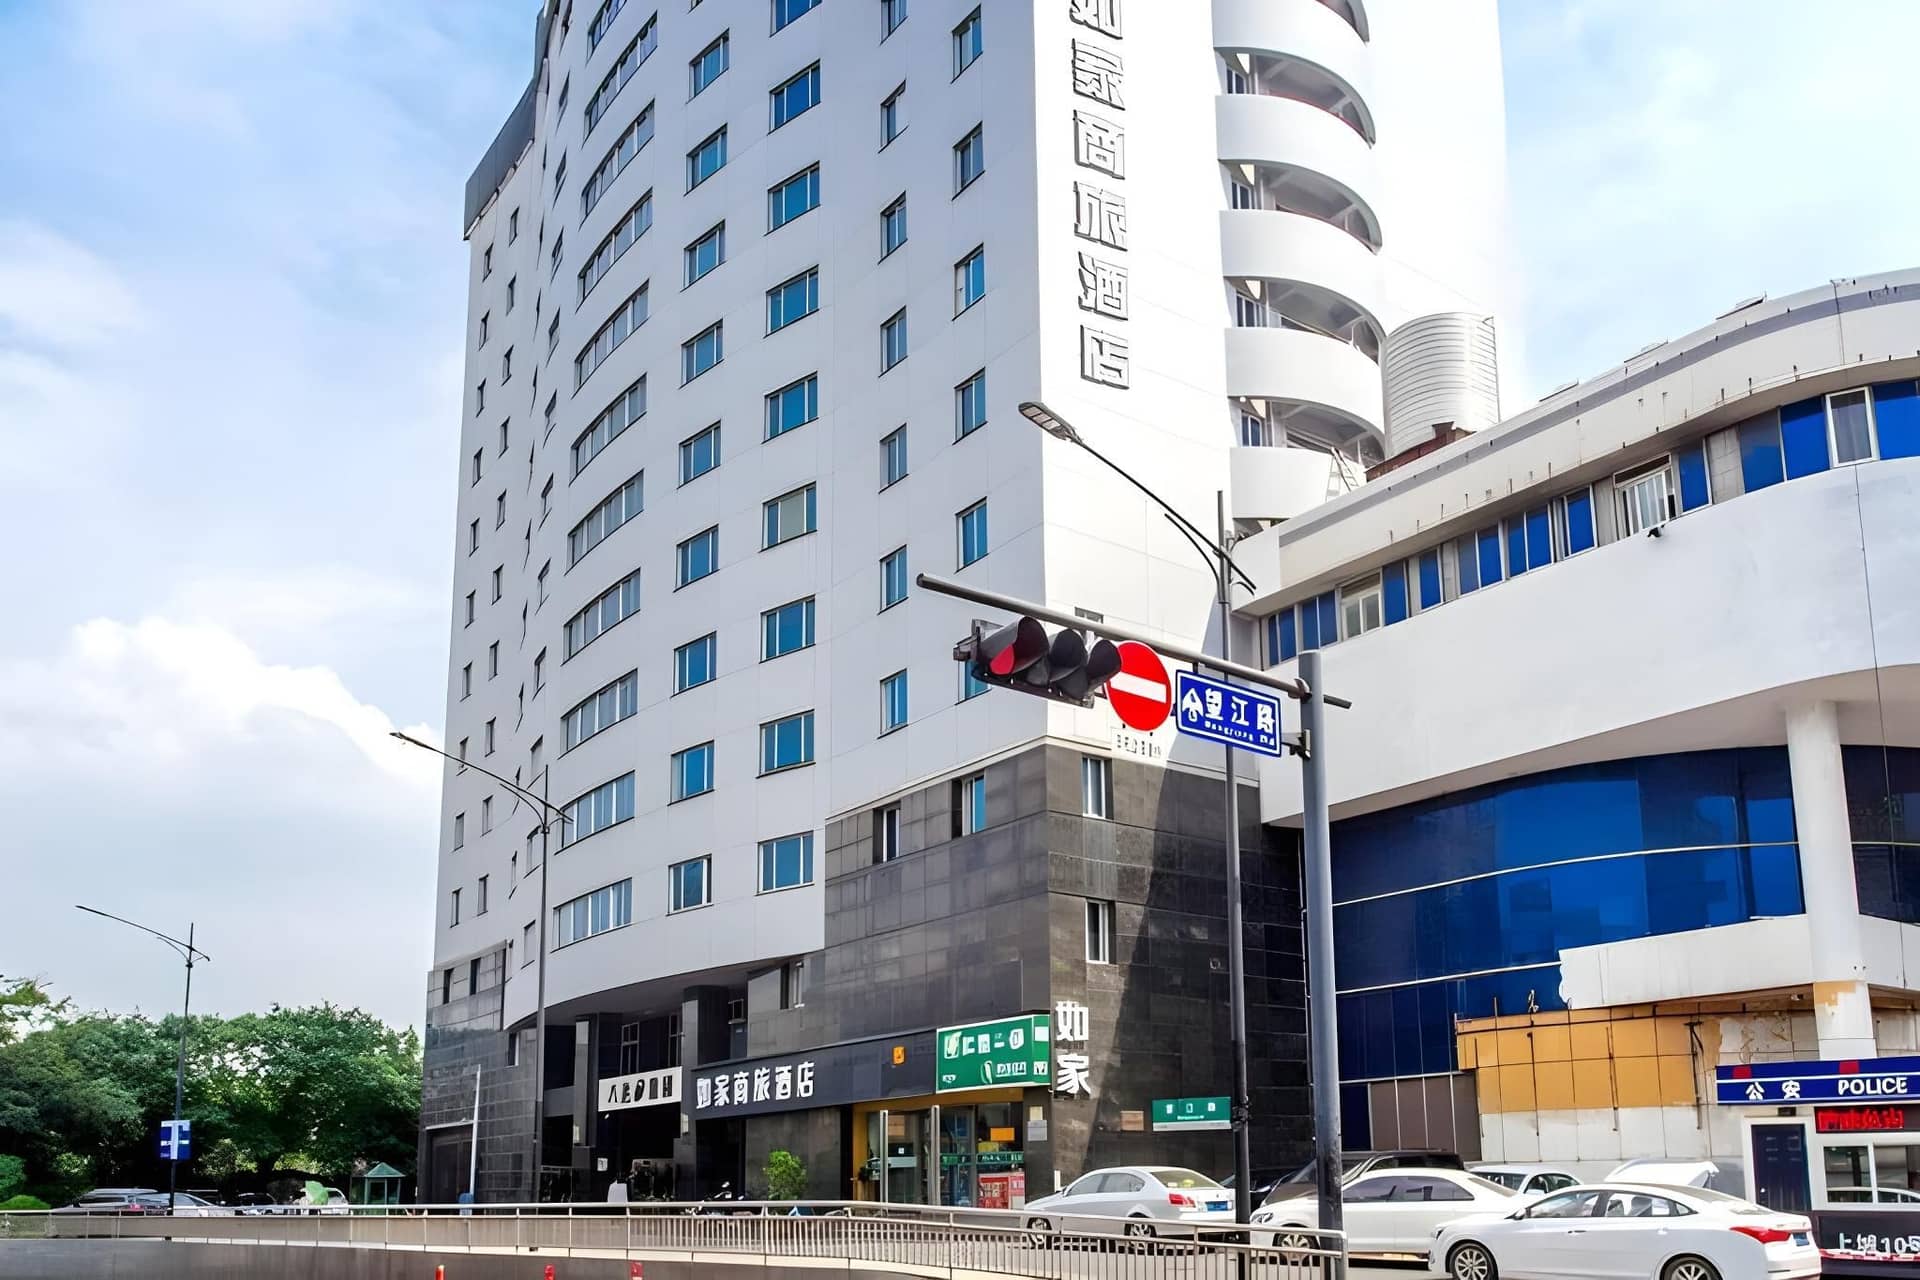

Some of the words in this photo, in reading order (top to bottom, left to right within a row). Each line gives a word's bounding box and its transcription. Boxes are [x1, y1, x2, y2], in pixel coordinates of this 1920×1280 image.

[1055, 1000, 1091, 1094] 如家
[696, 1062, 815, 1110] 如家商旅酒店
[1745, 1080, 1801, 1100] 公安
[1838, 1076, 1908, 1096] POLICE
